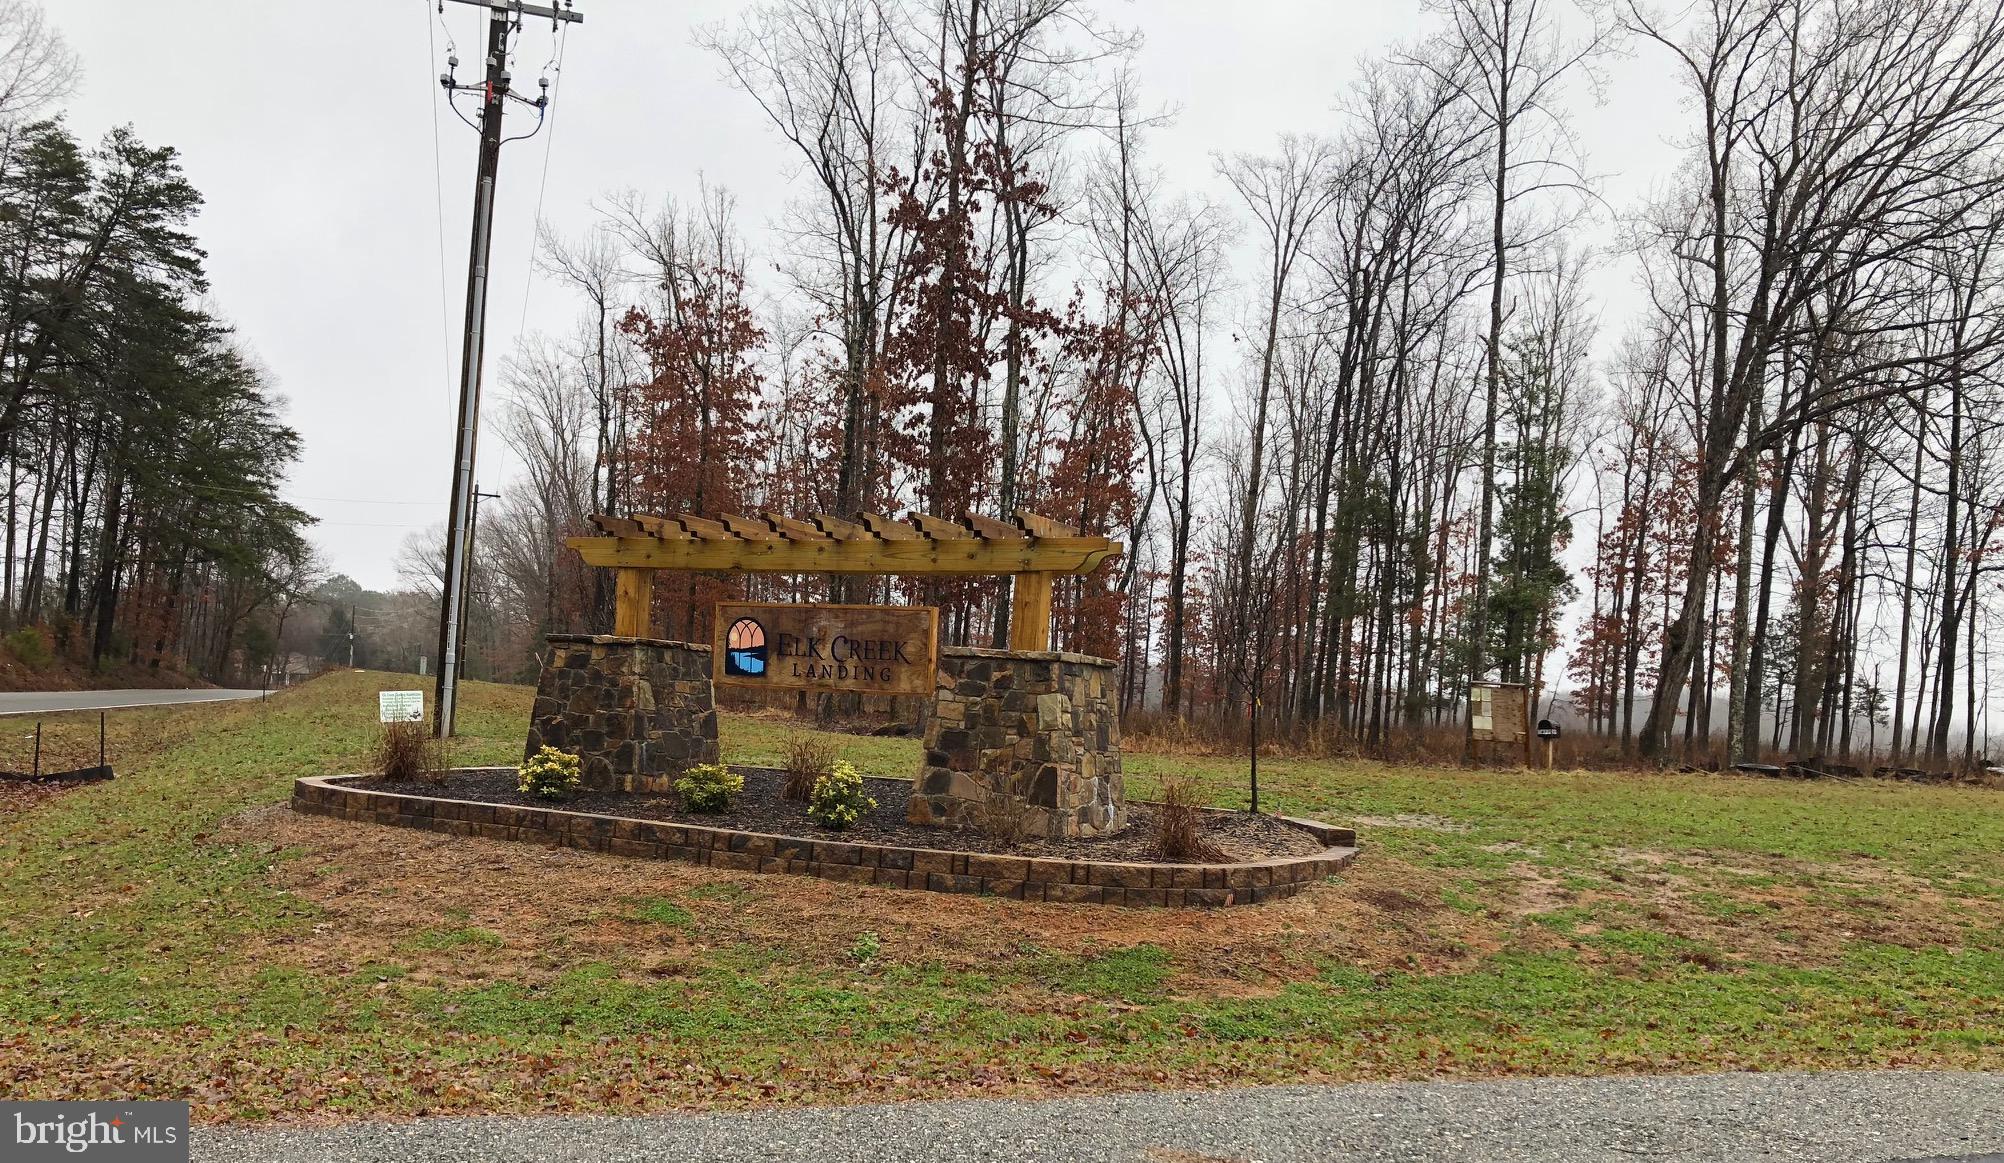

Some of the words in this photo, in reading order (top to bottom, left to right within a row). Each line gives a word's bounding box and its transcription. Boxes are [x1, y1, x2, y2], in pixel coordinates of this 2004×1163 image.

[777, 633, 825, 661] ELK
[831, 635, 912, 665] CREEK
[792, 662, 891, 682] LANDING
